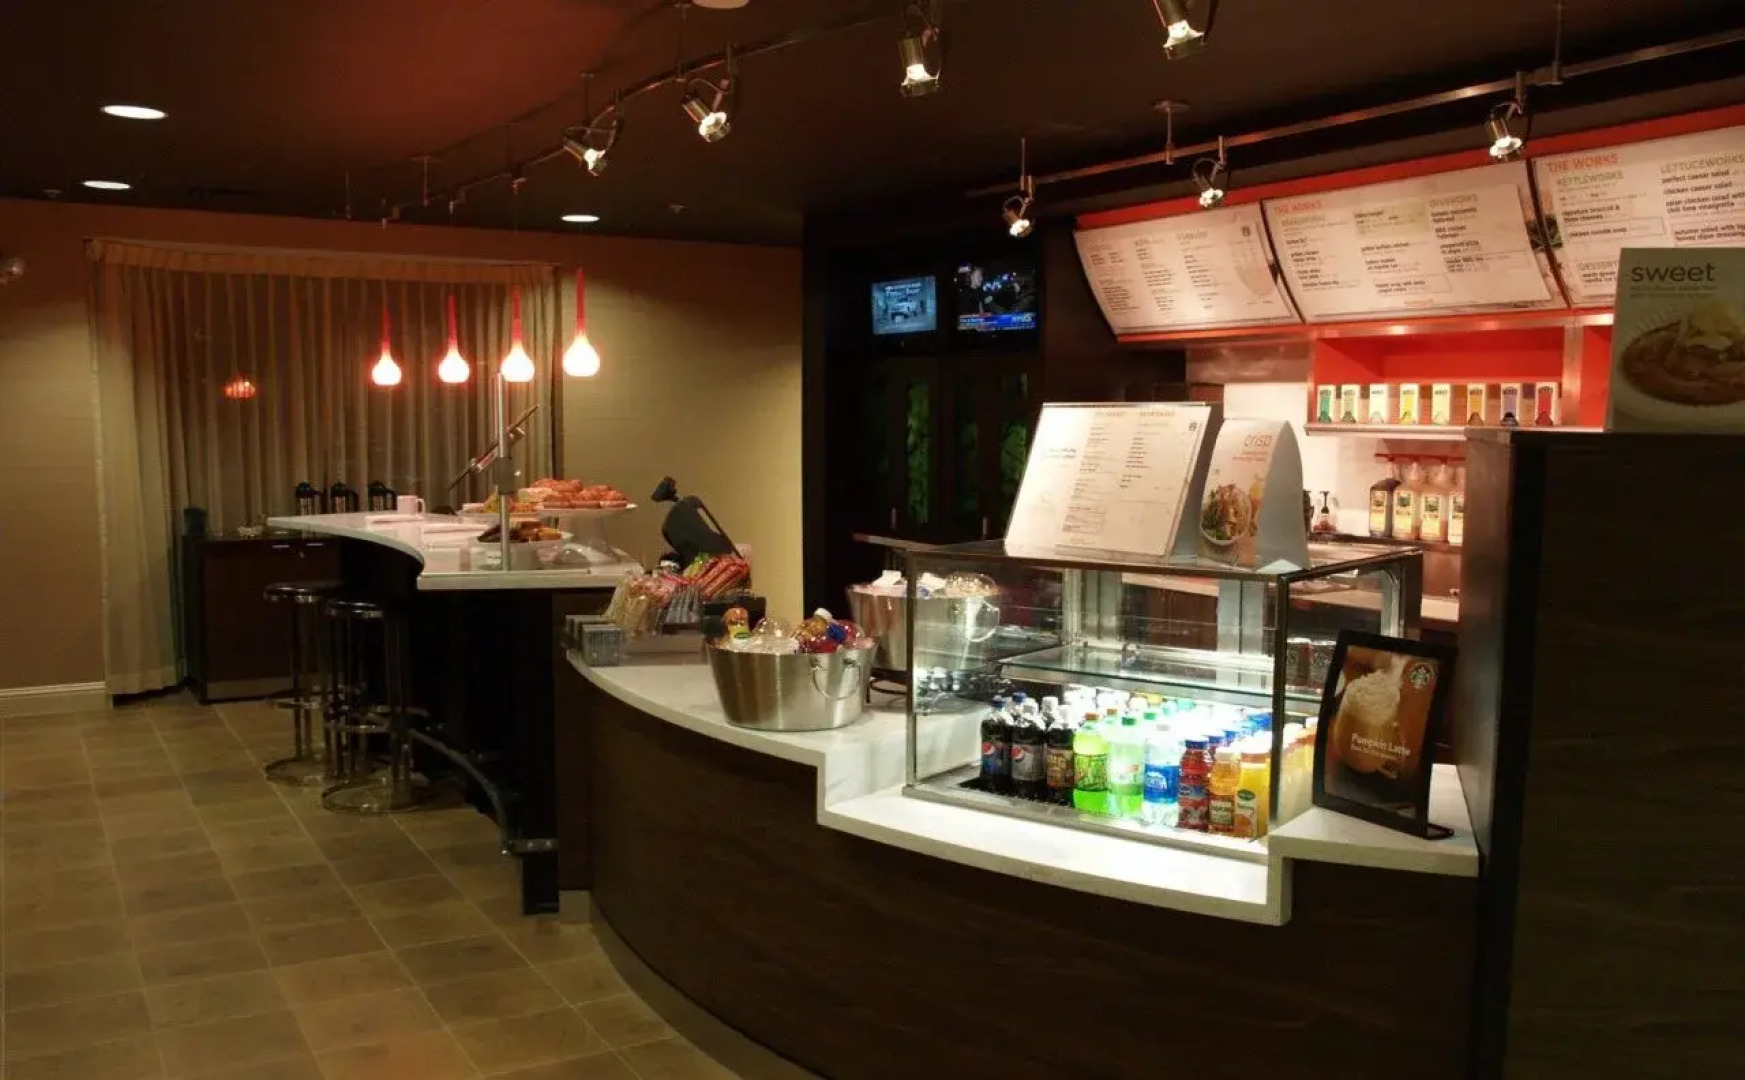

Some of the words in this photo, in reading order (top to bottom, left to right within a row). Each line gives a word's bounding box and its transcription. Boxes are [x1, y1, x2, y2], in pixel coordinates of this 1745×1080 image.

[1547, 160, 1570, 173] THE
[1572, 153, 1619, 169] WORKS
[1660, 153, 1745, 174] LETTUCEWORKS
[1710, 168, 1729, 177] salad
[1663, 187, 1689, 195] chicken
[1714, 180, 1732, 189] salad
[1684, 196, 1710, 204] chicken
[1631, 261, 1716, 283] sweet
[1351, 732, 1388, 751] Pumpkin
